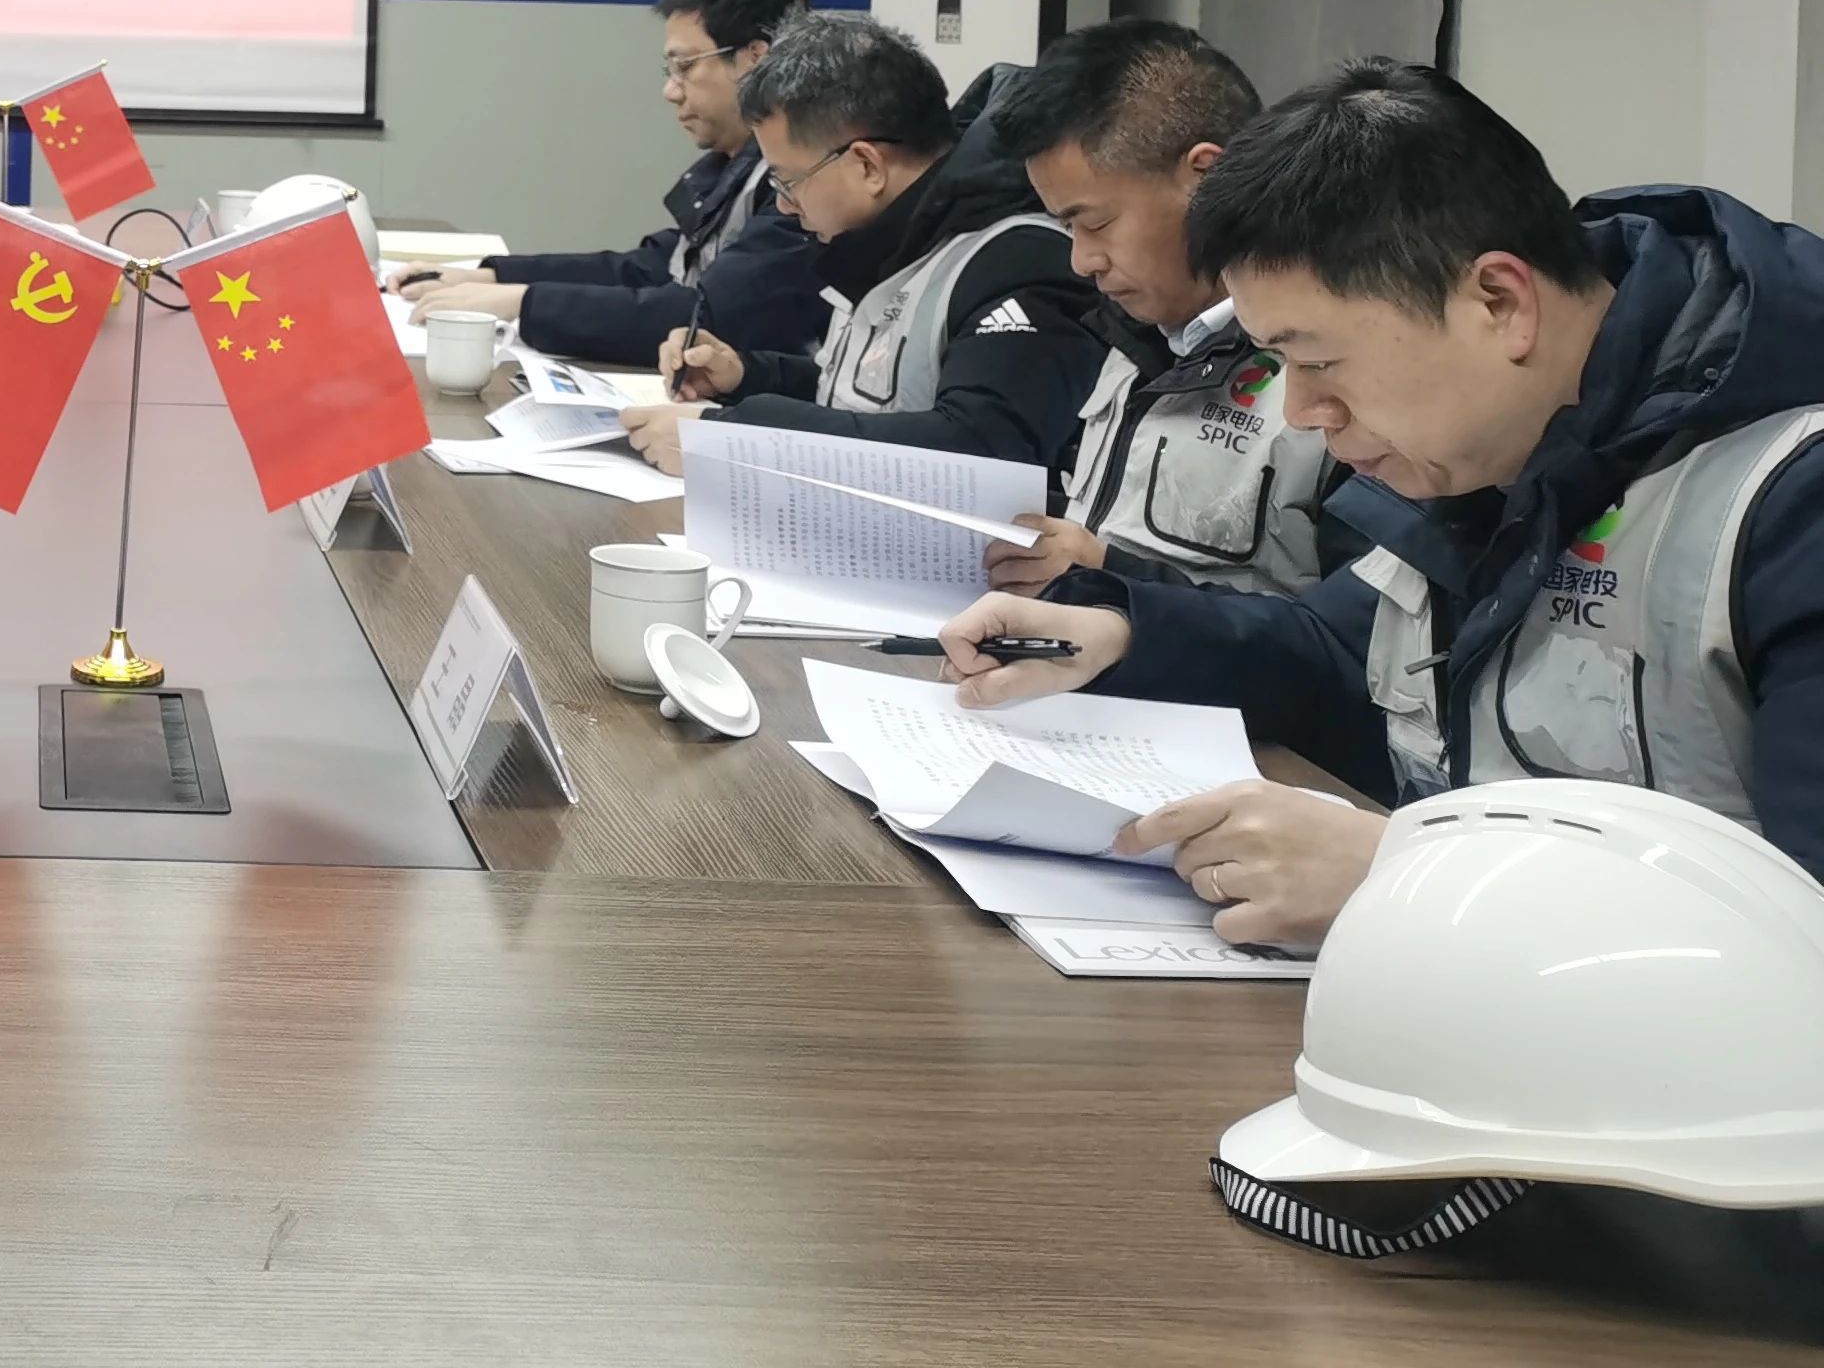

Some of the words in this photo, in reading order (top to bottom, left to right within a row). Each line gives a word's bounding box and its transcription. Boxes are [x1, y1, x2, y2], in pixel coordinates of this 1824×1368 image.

[1201, 402, 1264, 436] 国家电投
[1196, 423, 1249, 454] SPIC
[1549, 597, 1606, 629] SPIC
